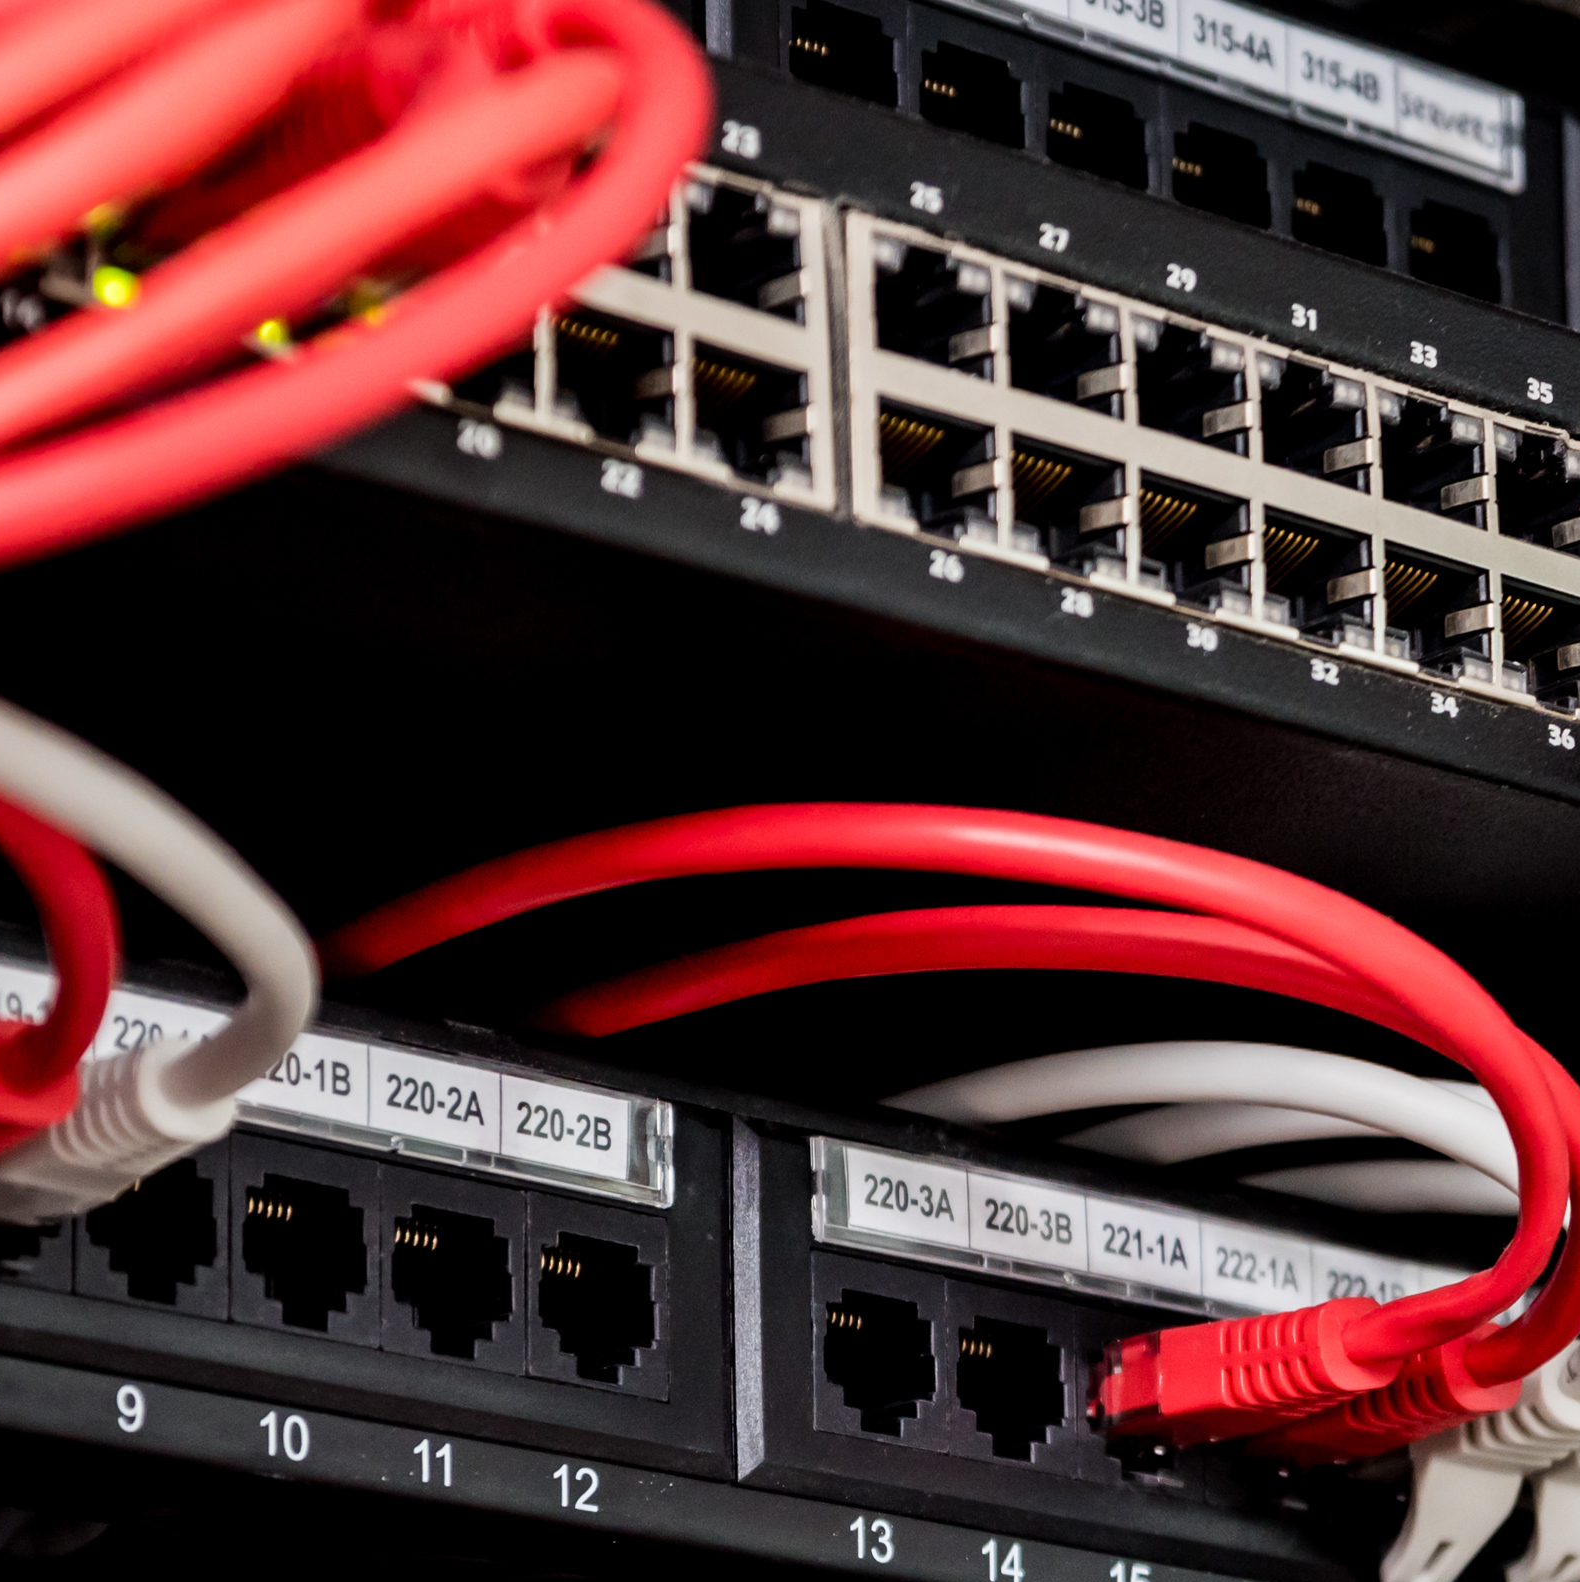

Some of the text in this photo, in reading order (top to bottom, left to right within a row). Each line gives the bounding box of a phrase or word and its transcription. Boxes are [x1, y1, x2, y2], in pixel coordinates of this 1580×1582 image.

[1194, 13, 1276, 68] 315-4A
[1300, 51, 1383, 102] 315-4B
[721, 120, 761, 159] 23
[909, 181, 944, 215] 25
[1038, 222, 1070, 253] 27
[1165, 262, 1198, 293] 29
[1291, 302, 1318, 332] 31
[1409, 340, 1438, 369] 33
[1526, 376, 1554, 405] 35
[738, 496, 783, 535] 24
[929, 548, 961, 582] 26
[1060, 585, 1094, 617] 28
[1186, 622, 1219, 652] 30
[1309, 657, 1340, 686] 32
[1430, 691, 1460, 719] 34
[1547, 723, 1576, 750] 36
[259, 1051, 351, 1097] 20-1B
[384, 1072, 486, 1128] 220-2A
[514, 1100, 614, 1153] 220-2B
[864, 1173, 955, 1223] 220-3A
[985, 1197, 1073, 1245] 220-3B
[1102, 1222, 1188, 1270] 221-1A
[1216, 1246, 1299, 1294] 222-1A
[116, 1384, 146, 1433] 9
[259, 1410, 311, 1462] 10
[413, 1438, 452, 1487] 11
[552, 1463, 599, 1513] 12
[849, 1515, 895, 1564] 13
